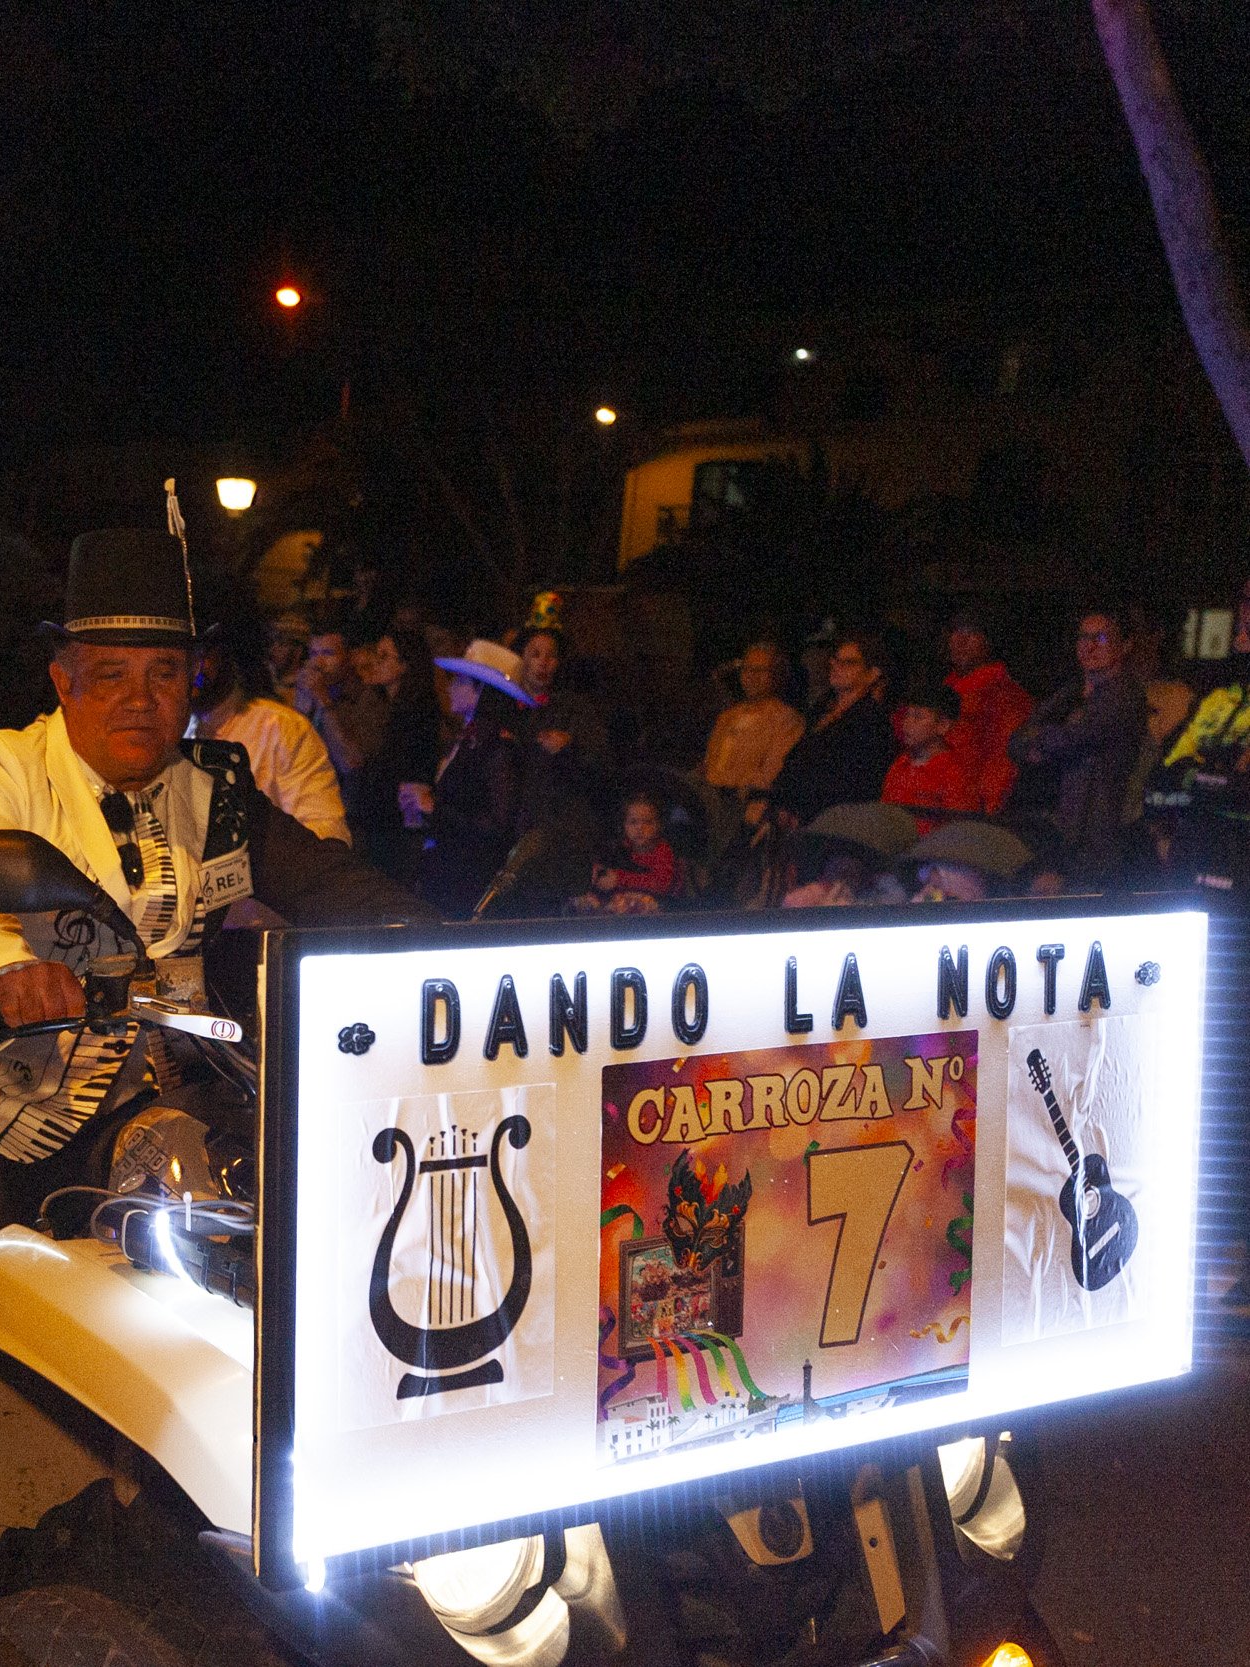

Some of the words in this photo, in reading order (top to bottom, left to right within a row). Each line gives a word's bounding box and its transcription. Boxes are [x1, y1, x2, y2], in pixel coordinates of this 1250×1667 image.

[420, 962, 709, 1066] DANDO
[784, 952, 868, 1034] LA
[937, 940, 1112, 1020] NOTA
[124, 1126, 168, 1172] QUAD
[626, 1064, 894, 1145] CARROZA
[806, 1139, 915, 1349] 7
